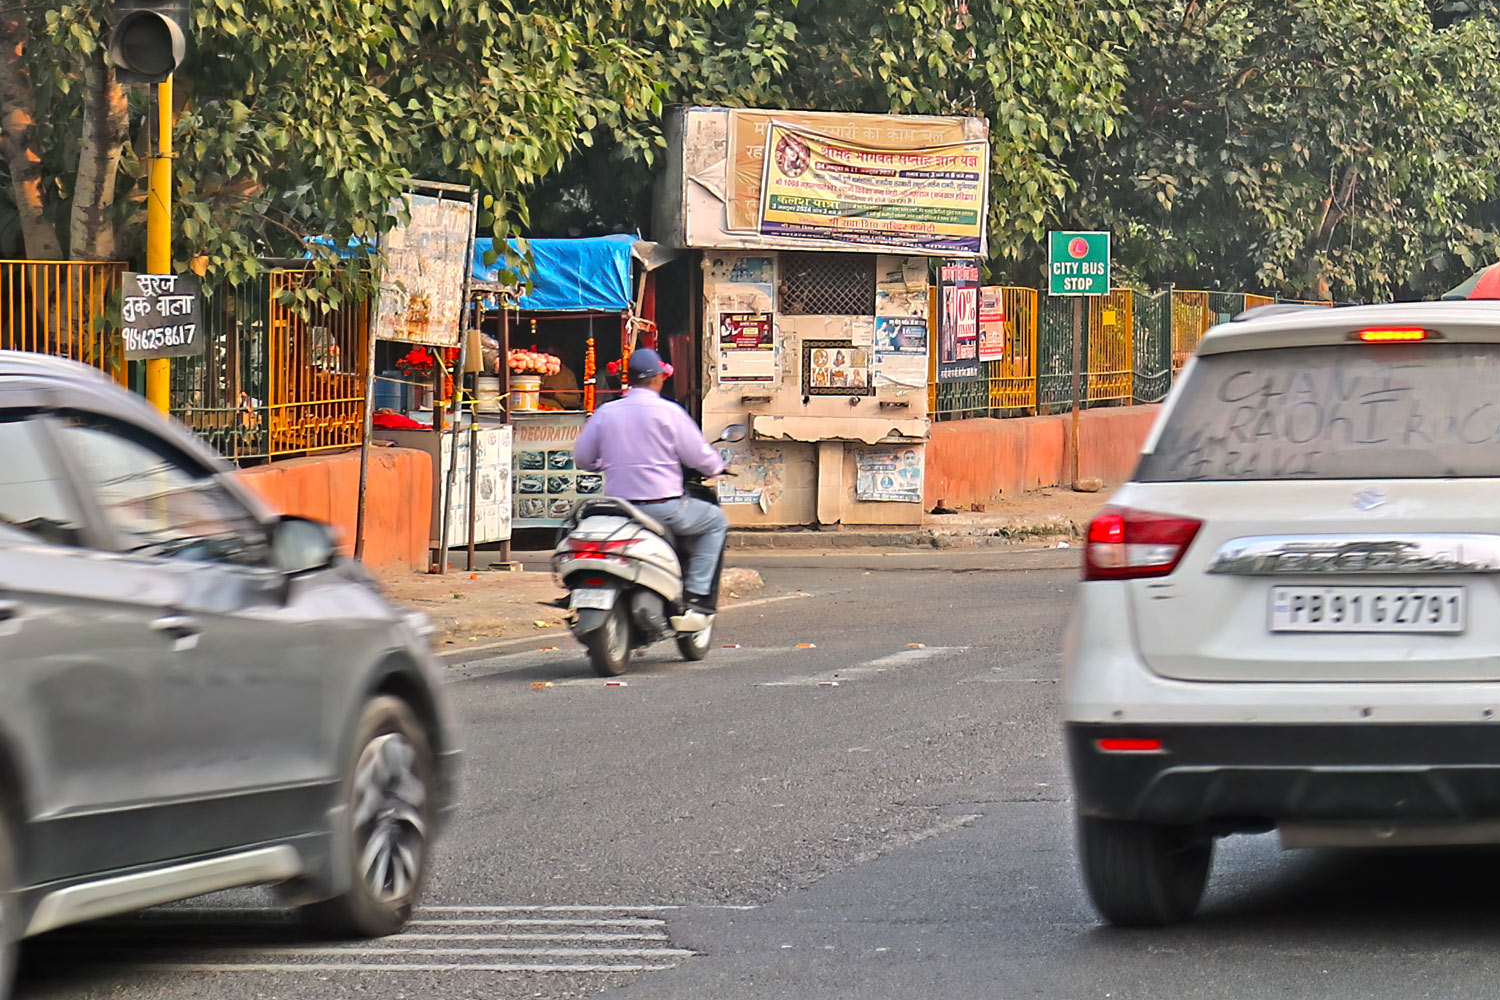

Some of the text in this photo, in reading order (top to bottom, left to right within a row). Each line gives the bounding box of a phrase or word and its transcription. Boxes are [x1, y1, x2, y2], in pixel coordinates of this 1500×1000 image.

[1053, 262, 1104, 275] CITY BUS
[136, 275, 178, 296] सूरज
[1064, 277, 1093, 290] STOP
[156, 294, 195, 317] वाला
[958, 290, 975, 321] 0%
[122, 324, 196, 351] 9646258617
